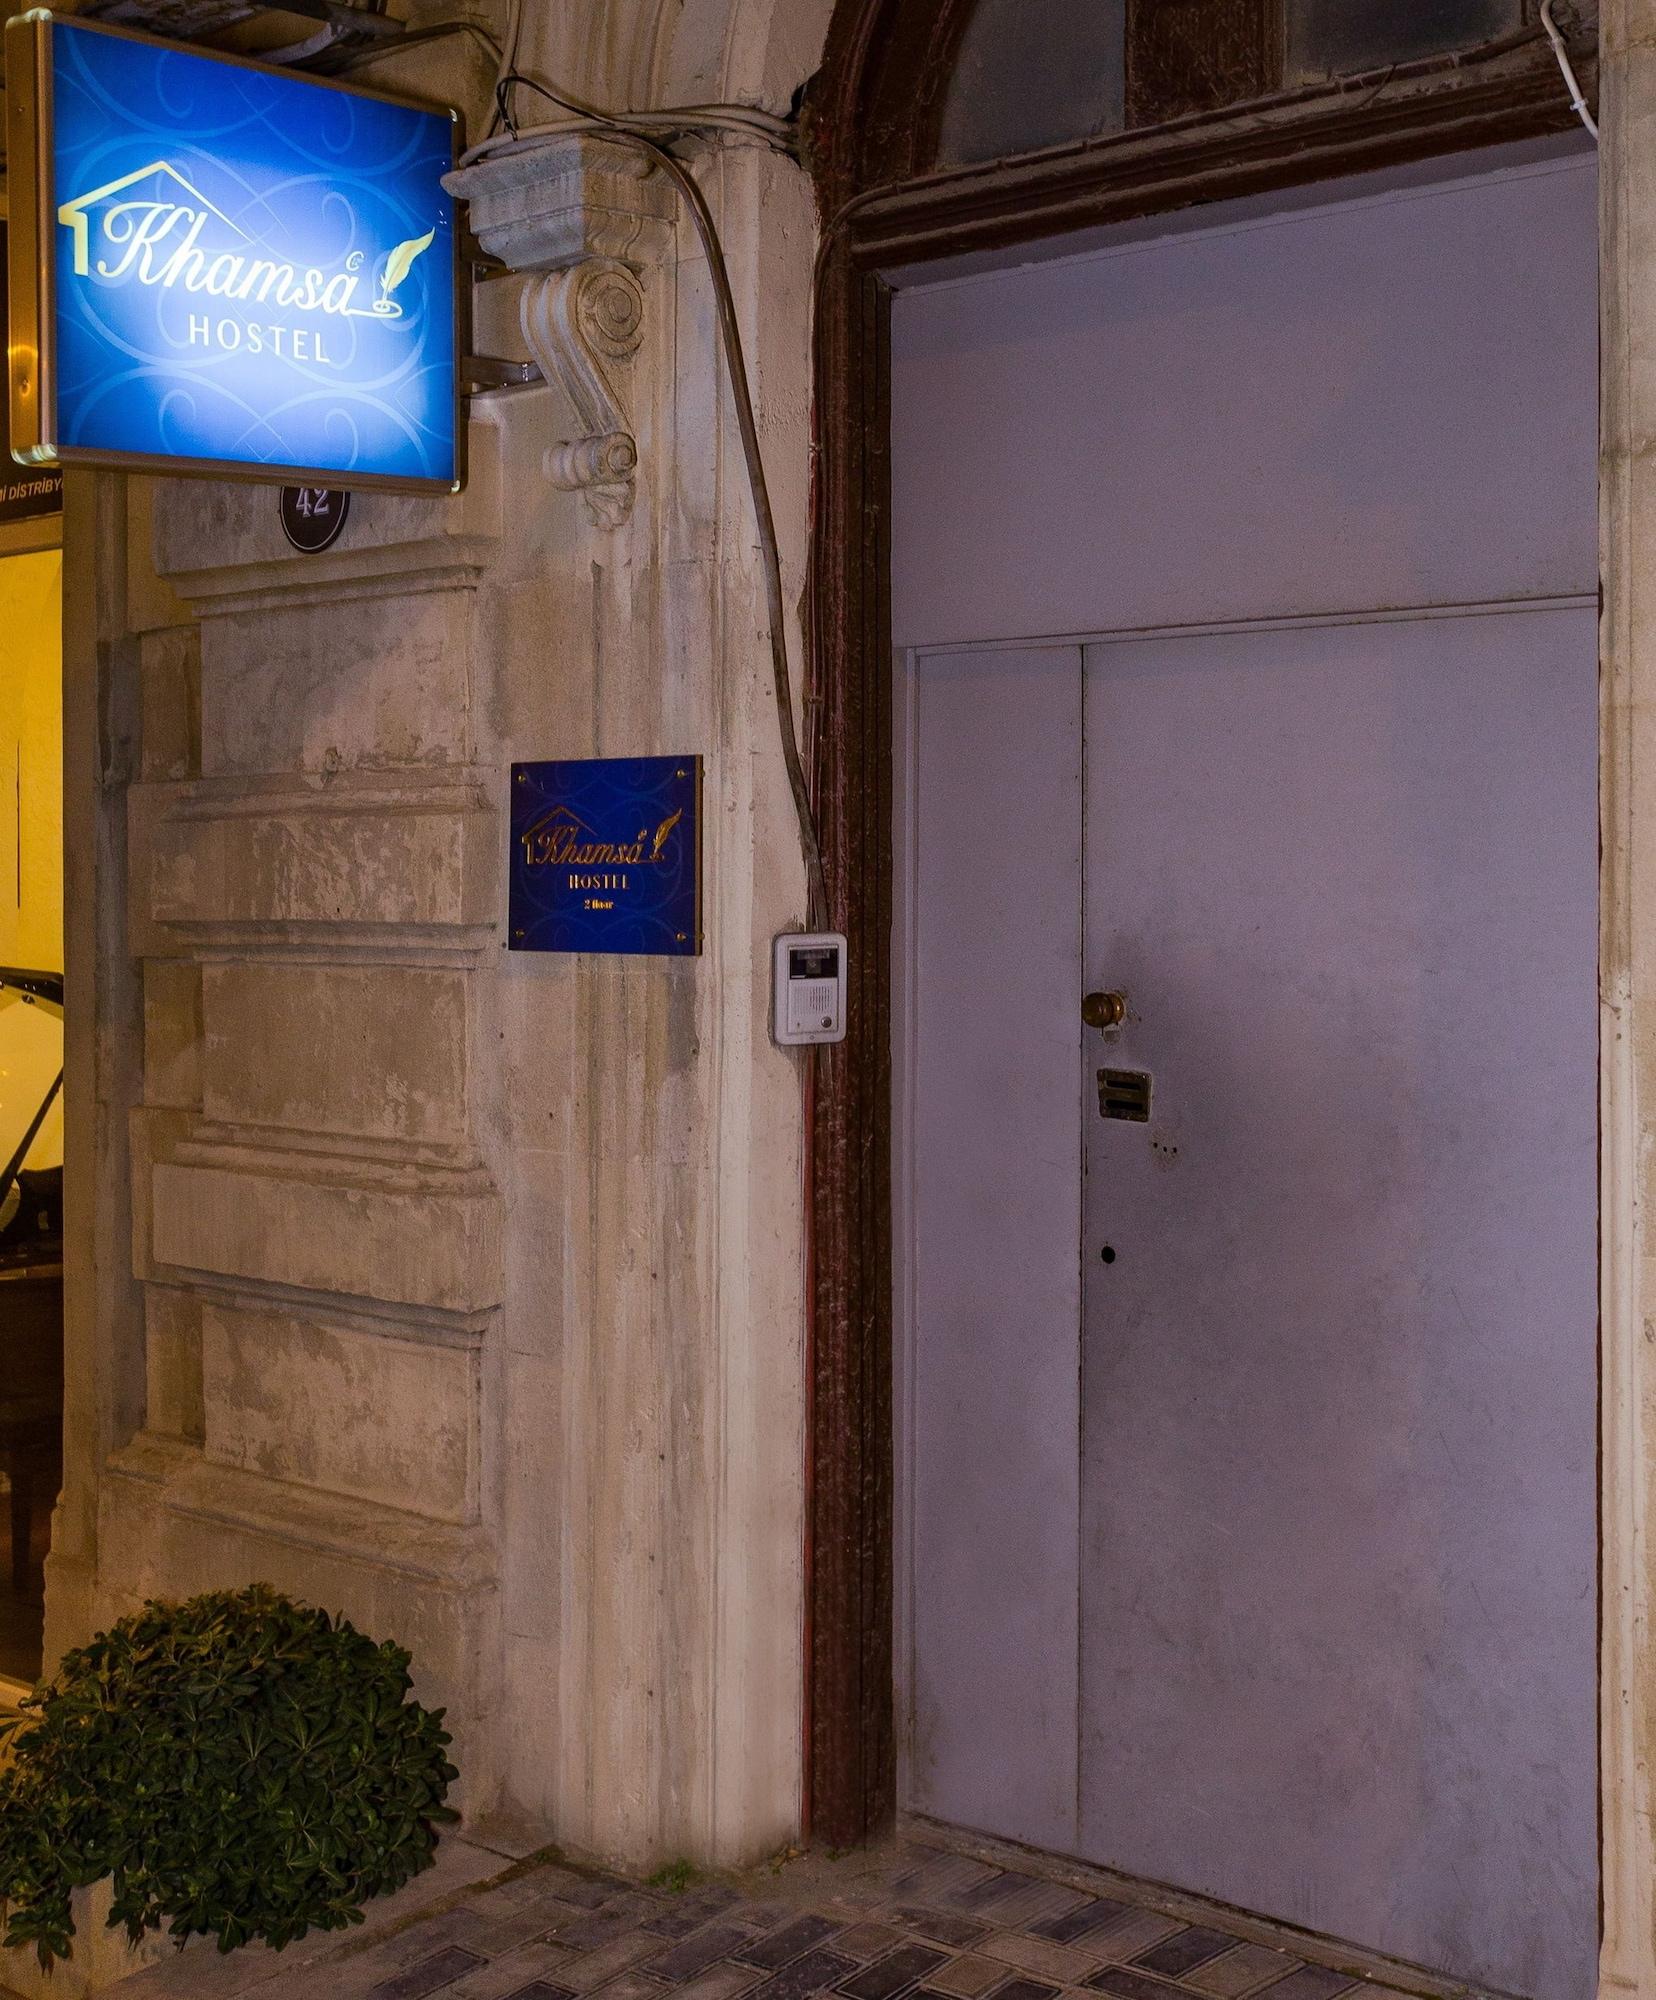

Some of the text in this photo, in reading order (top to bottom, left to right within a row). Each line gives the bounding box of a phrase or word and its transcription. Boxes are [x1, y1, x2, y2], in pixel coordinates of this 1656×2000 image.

[189, 315, 330, 362] HOSTEL
[8, 478, 63, 499] DİSTRİBY
[296, 488, 329, 518] 42
[569, 874, 629, 889] HOSTEL
